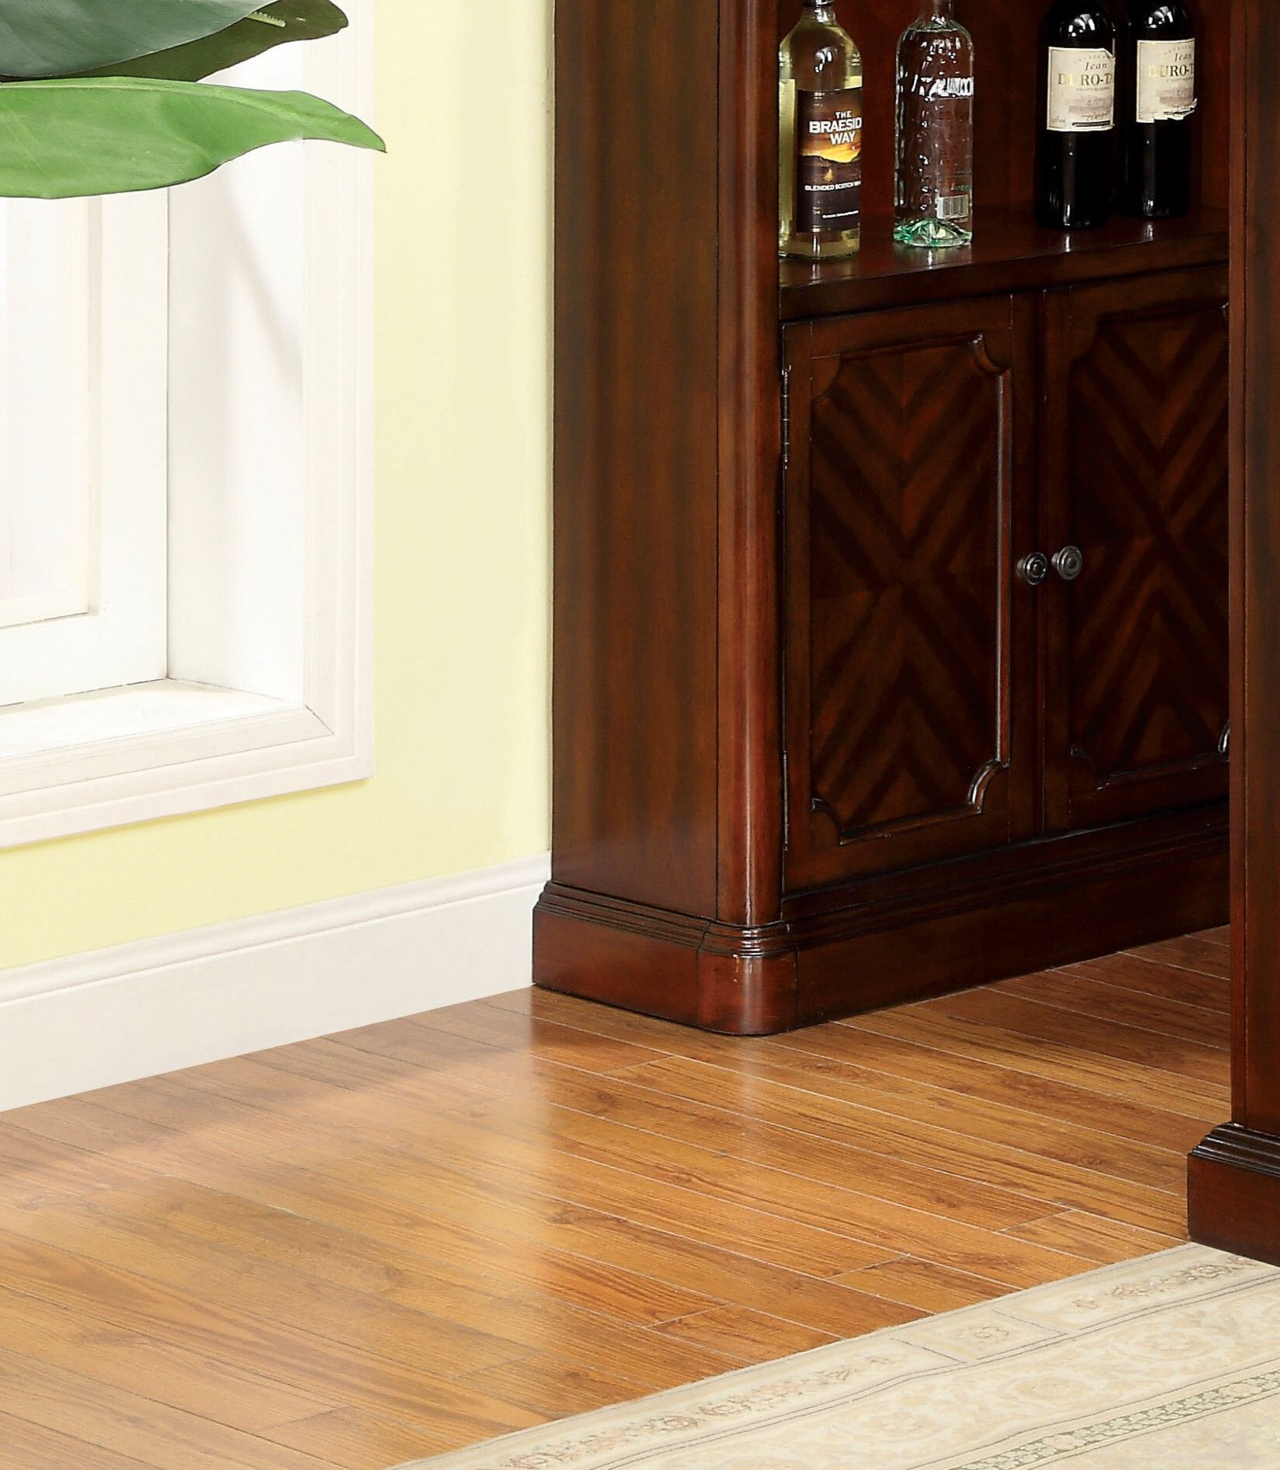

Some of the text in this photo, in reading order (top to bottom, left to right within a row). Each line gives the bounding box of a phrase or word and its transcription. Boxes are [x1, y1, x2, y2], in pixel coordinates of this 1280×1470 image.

[1084, 62, 1108, 71] Jean
[835, 111, 852, 119] THE
[808, 117, 863, 134] BRAESID
[830, 131, 856, 145] WAY
